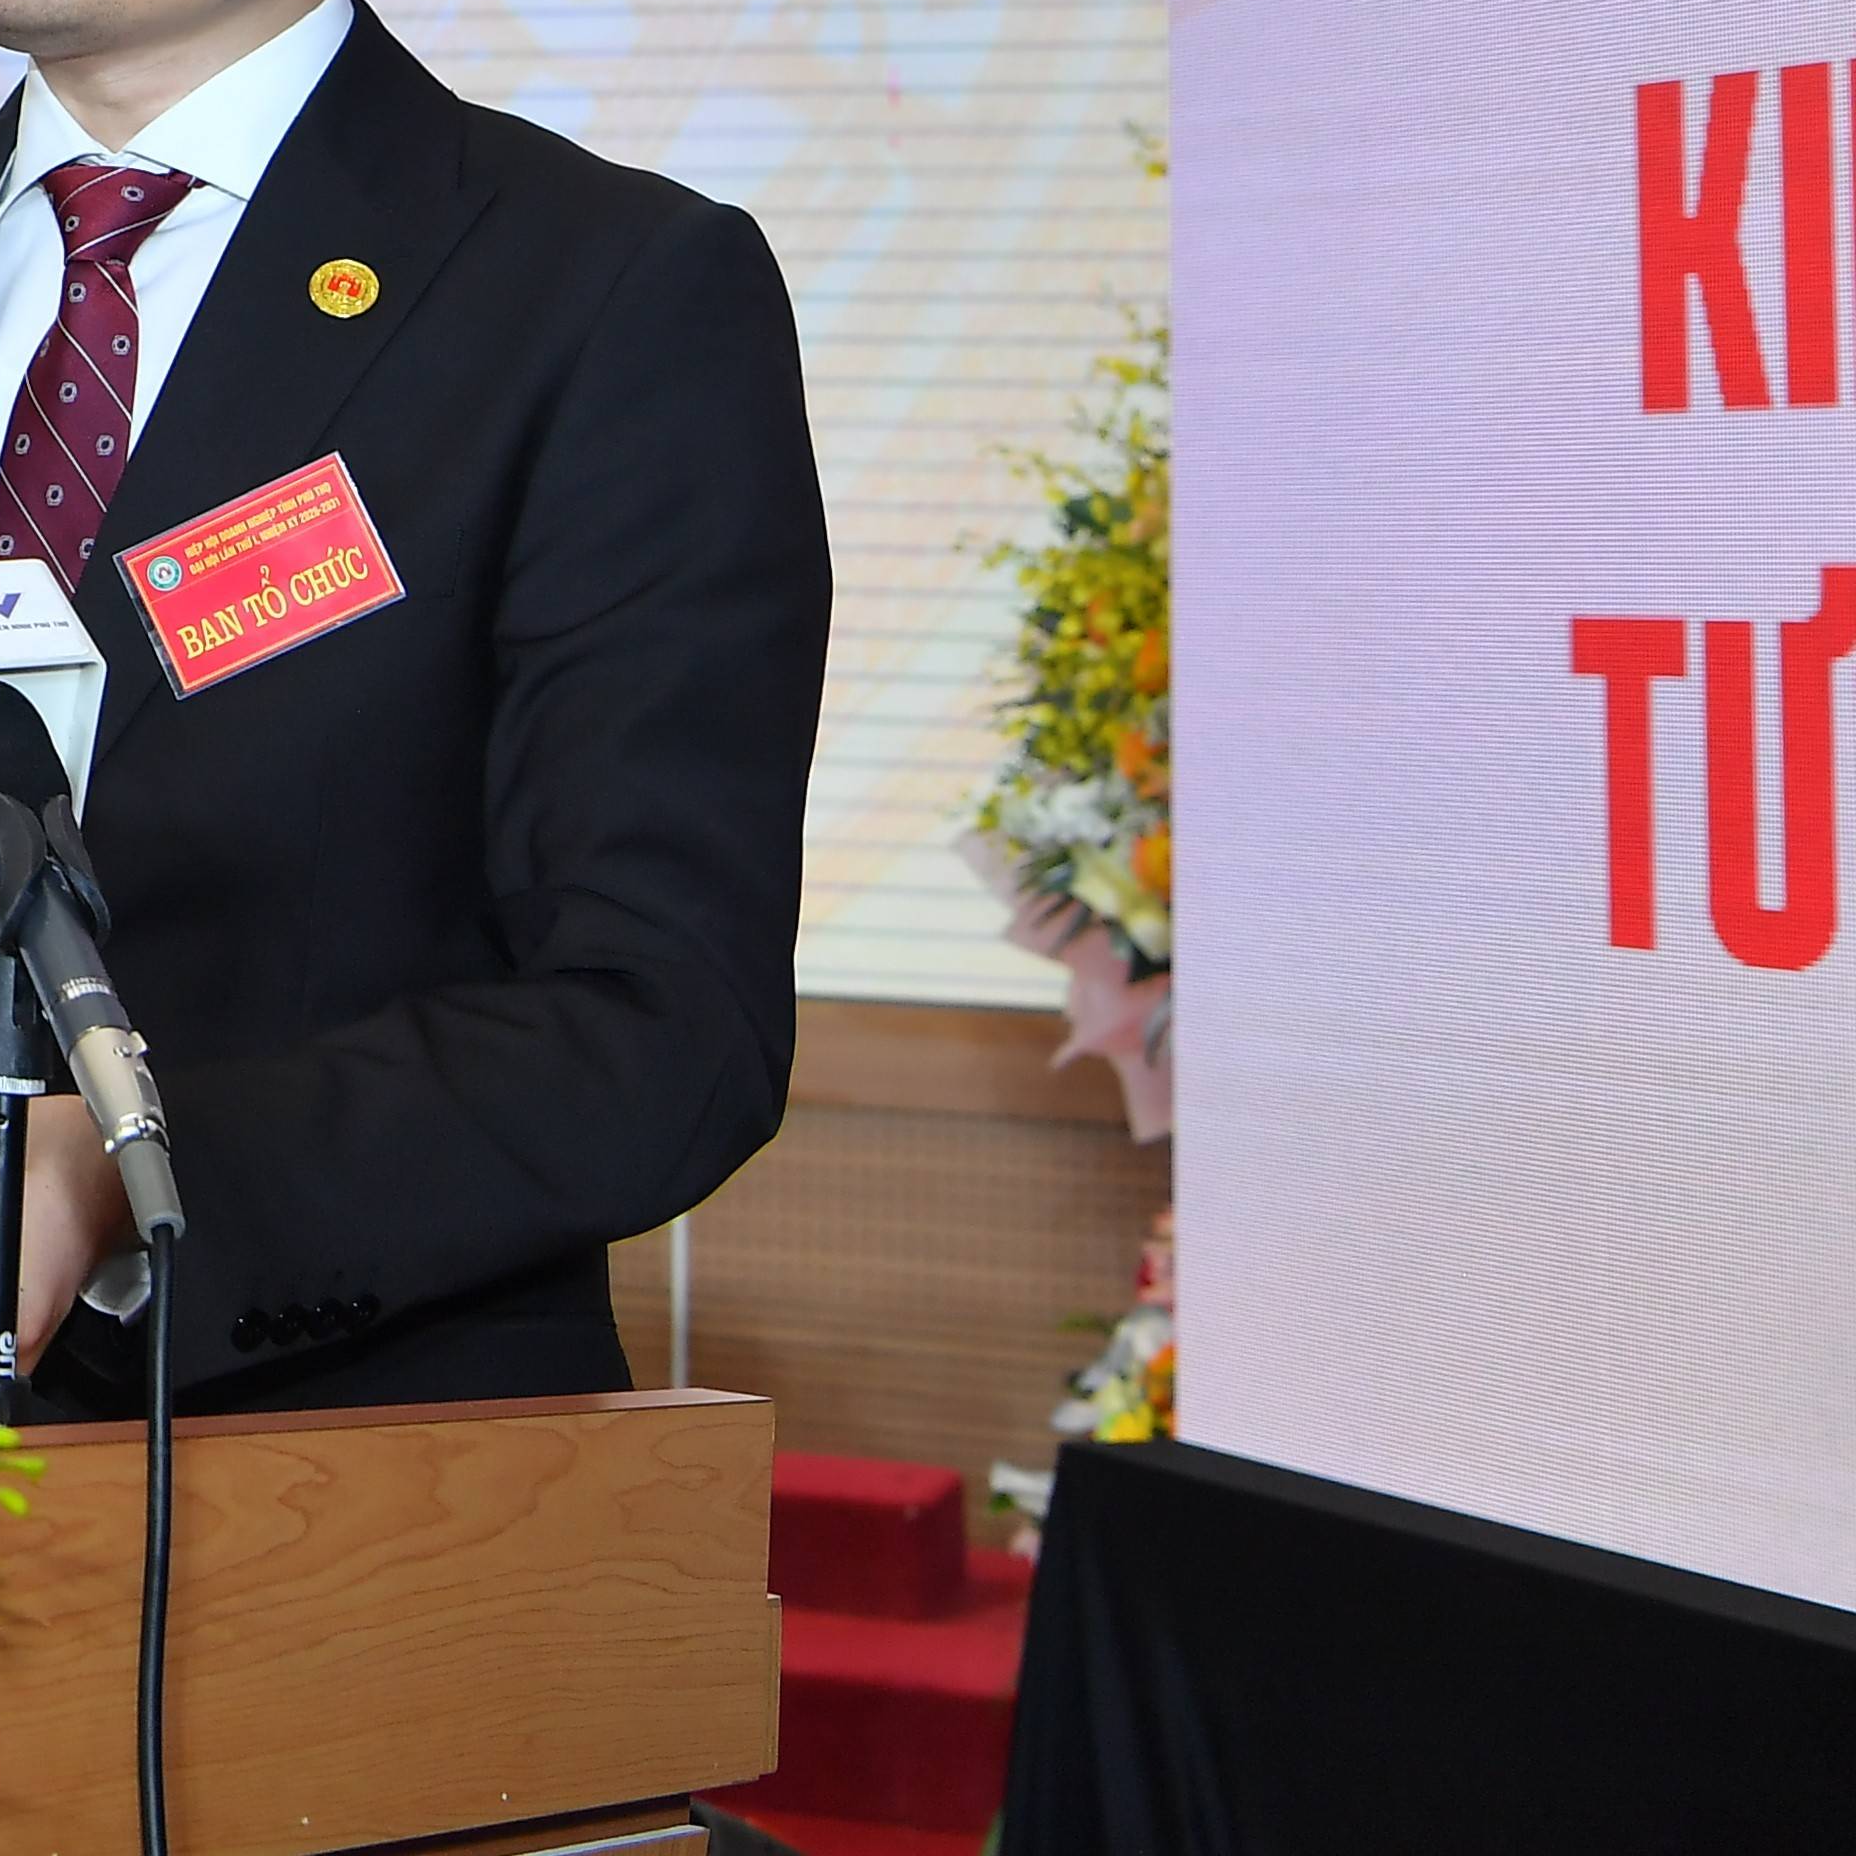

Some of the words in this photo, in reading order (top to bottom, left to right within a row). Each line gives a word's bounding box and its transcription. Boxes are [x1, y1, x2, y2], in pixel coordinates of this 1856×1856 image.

[177, 605, 244, 658] BAN
[242, 566, 287, 627] TỔ
[290, 546, 368, 605] CHỨC
